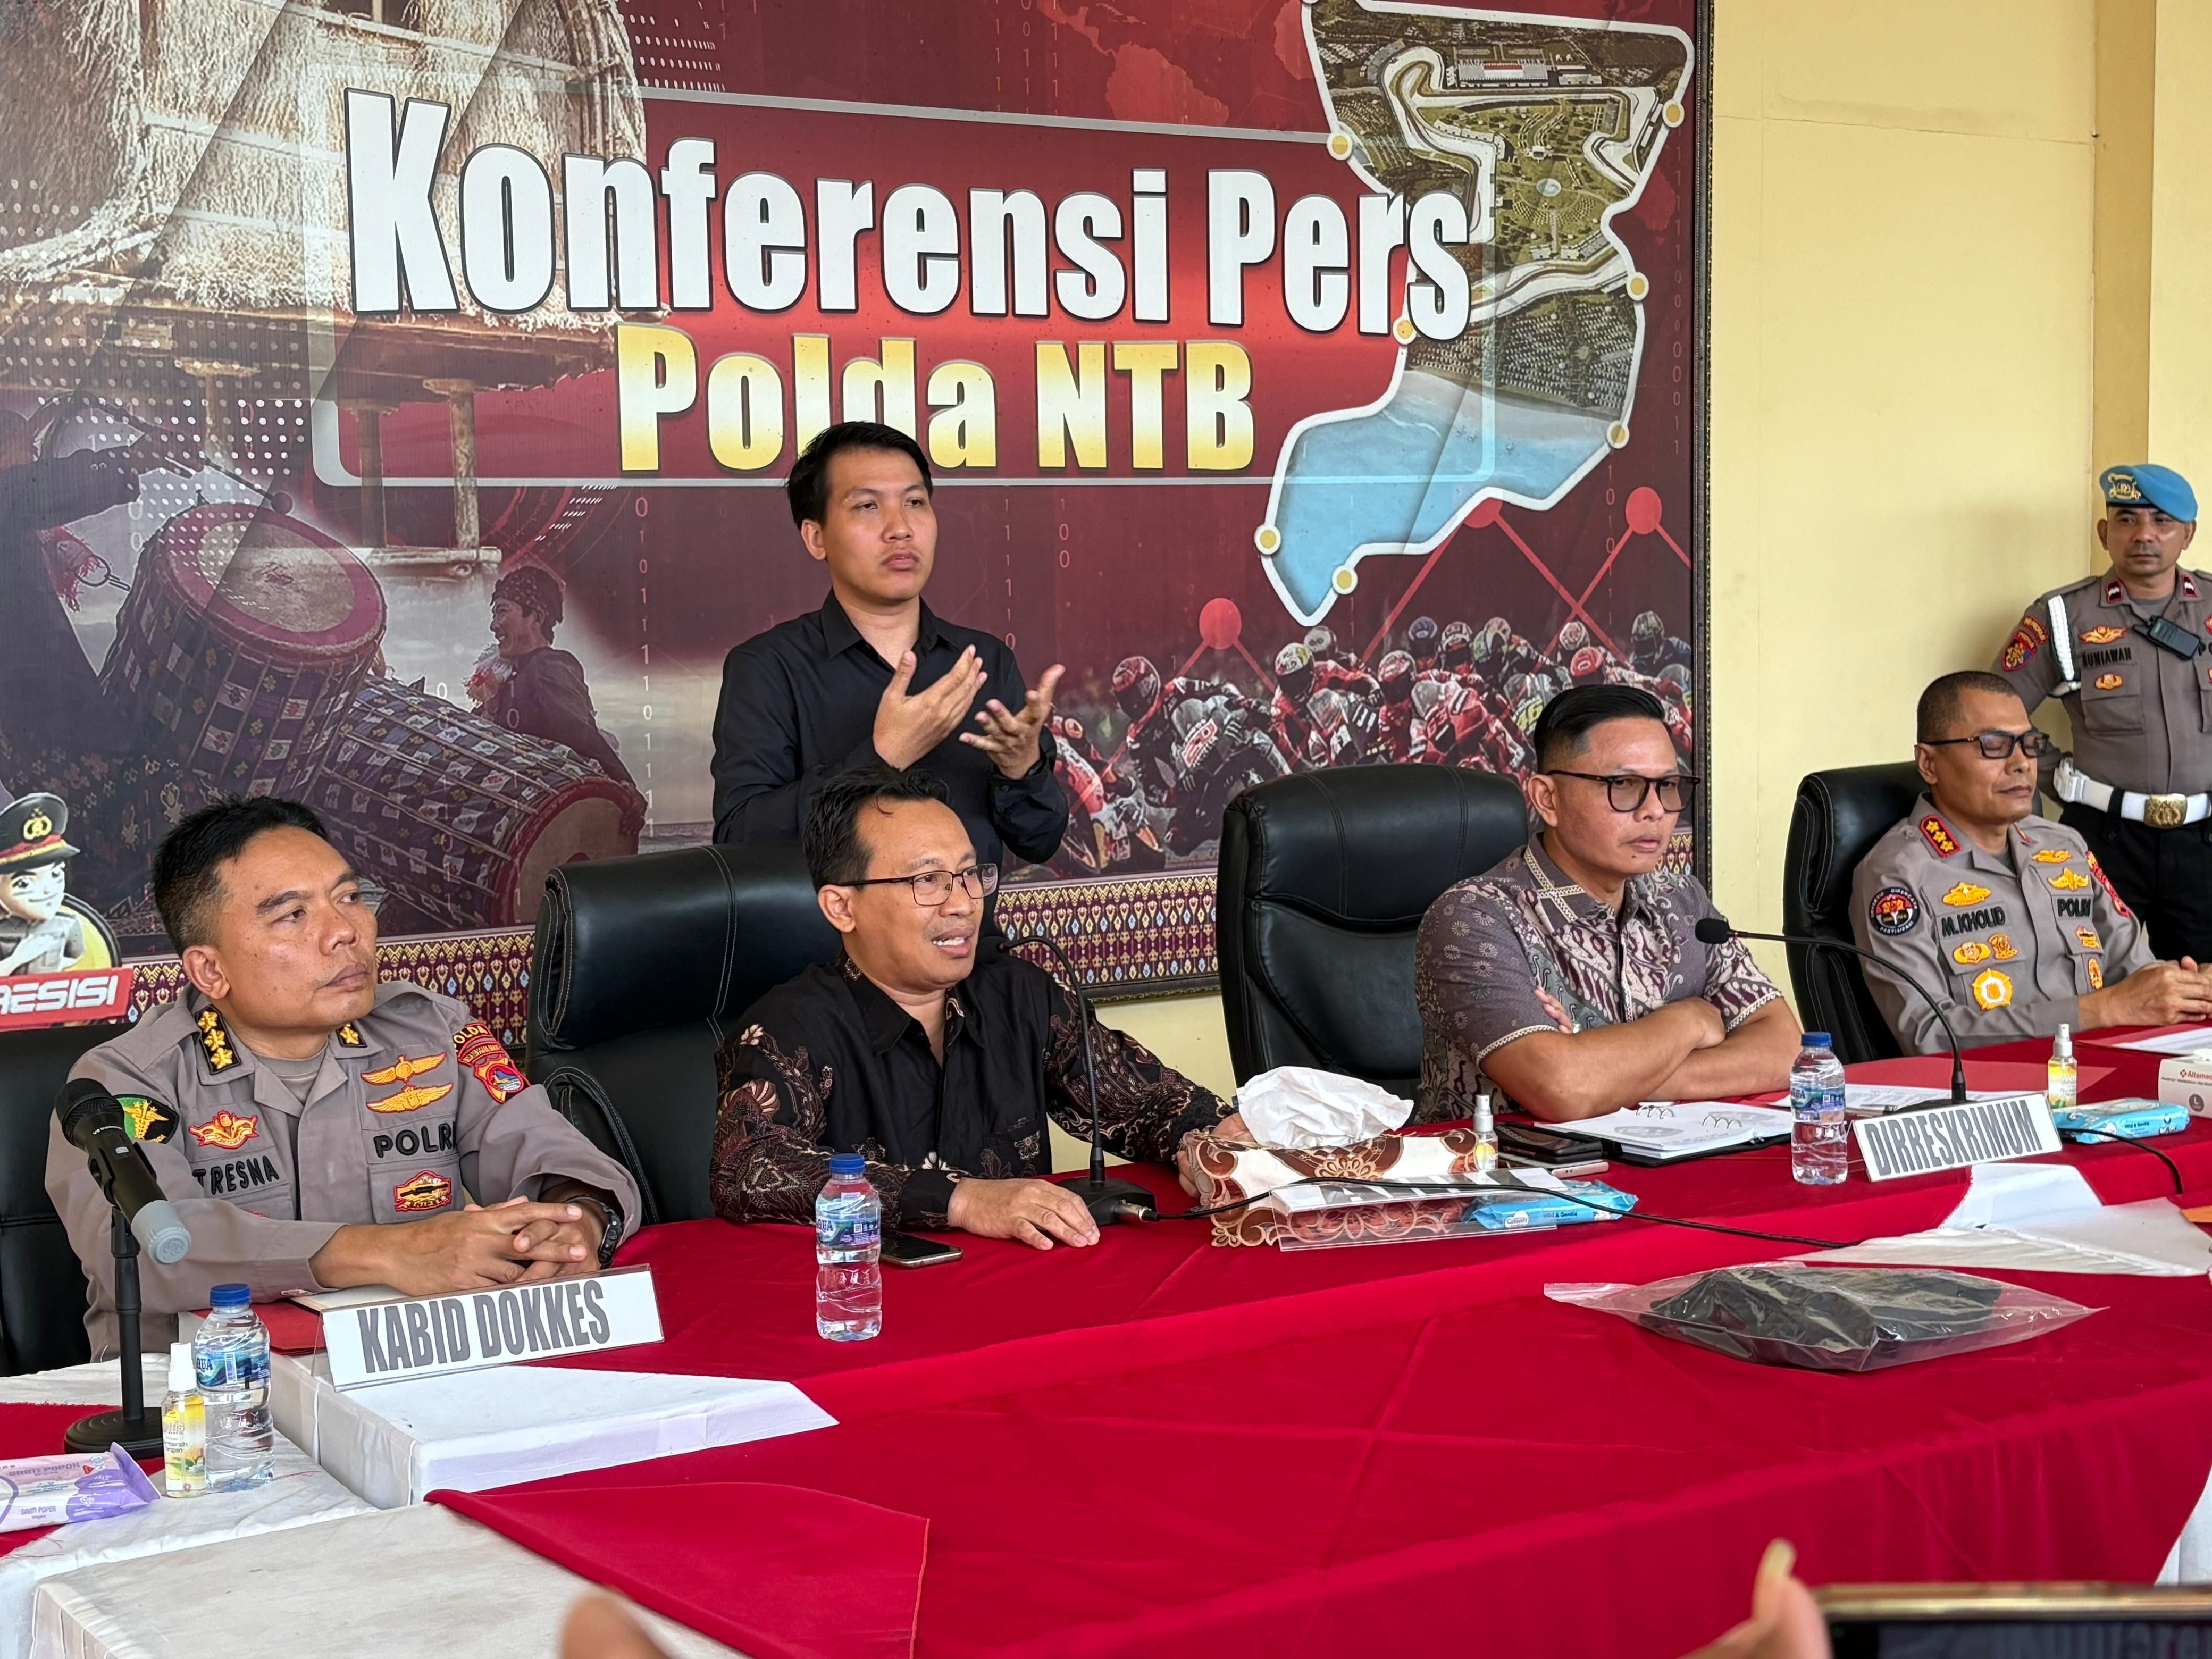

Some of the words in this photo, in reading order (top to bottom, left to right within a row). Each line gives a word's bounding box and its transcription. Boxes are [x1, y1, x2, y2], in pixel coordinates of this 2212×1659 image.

[345, 88, 1171, 322] Konferensi
[1207, 168, 1471, 341] Pers
[616, 322, 997, 472] Polda
[1035, 340, 1255, 470] NTB
[1941, 906, 2006, 937] M.KHOLID
[374, 1122, 456, 1158] POLRI
[1864, 1100, 2043, 1176] DIRRESKRIMUM
[192, 1155, 280, 1195] TRESNA
[356, 1298, 471, 1373] KABID
[473, 1280, 610, 1359] DOKKES
[196, 1357, 213, 1372] QUA
